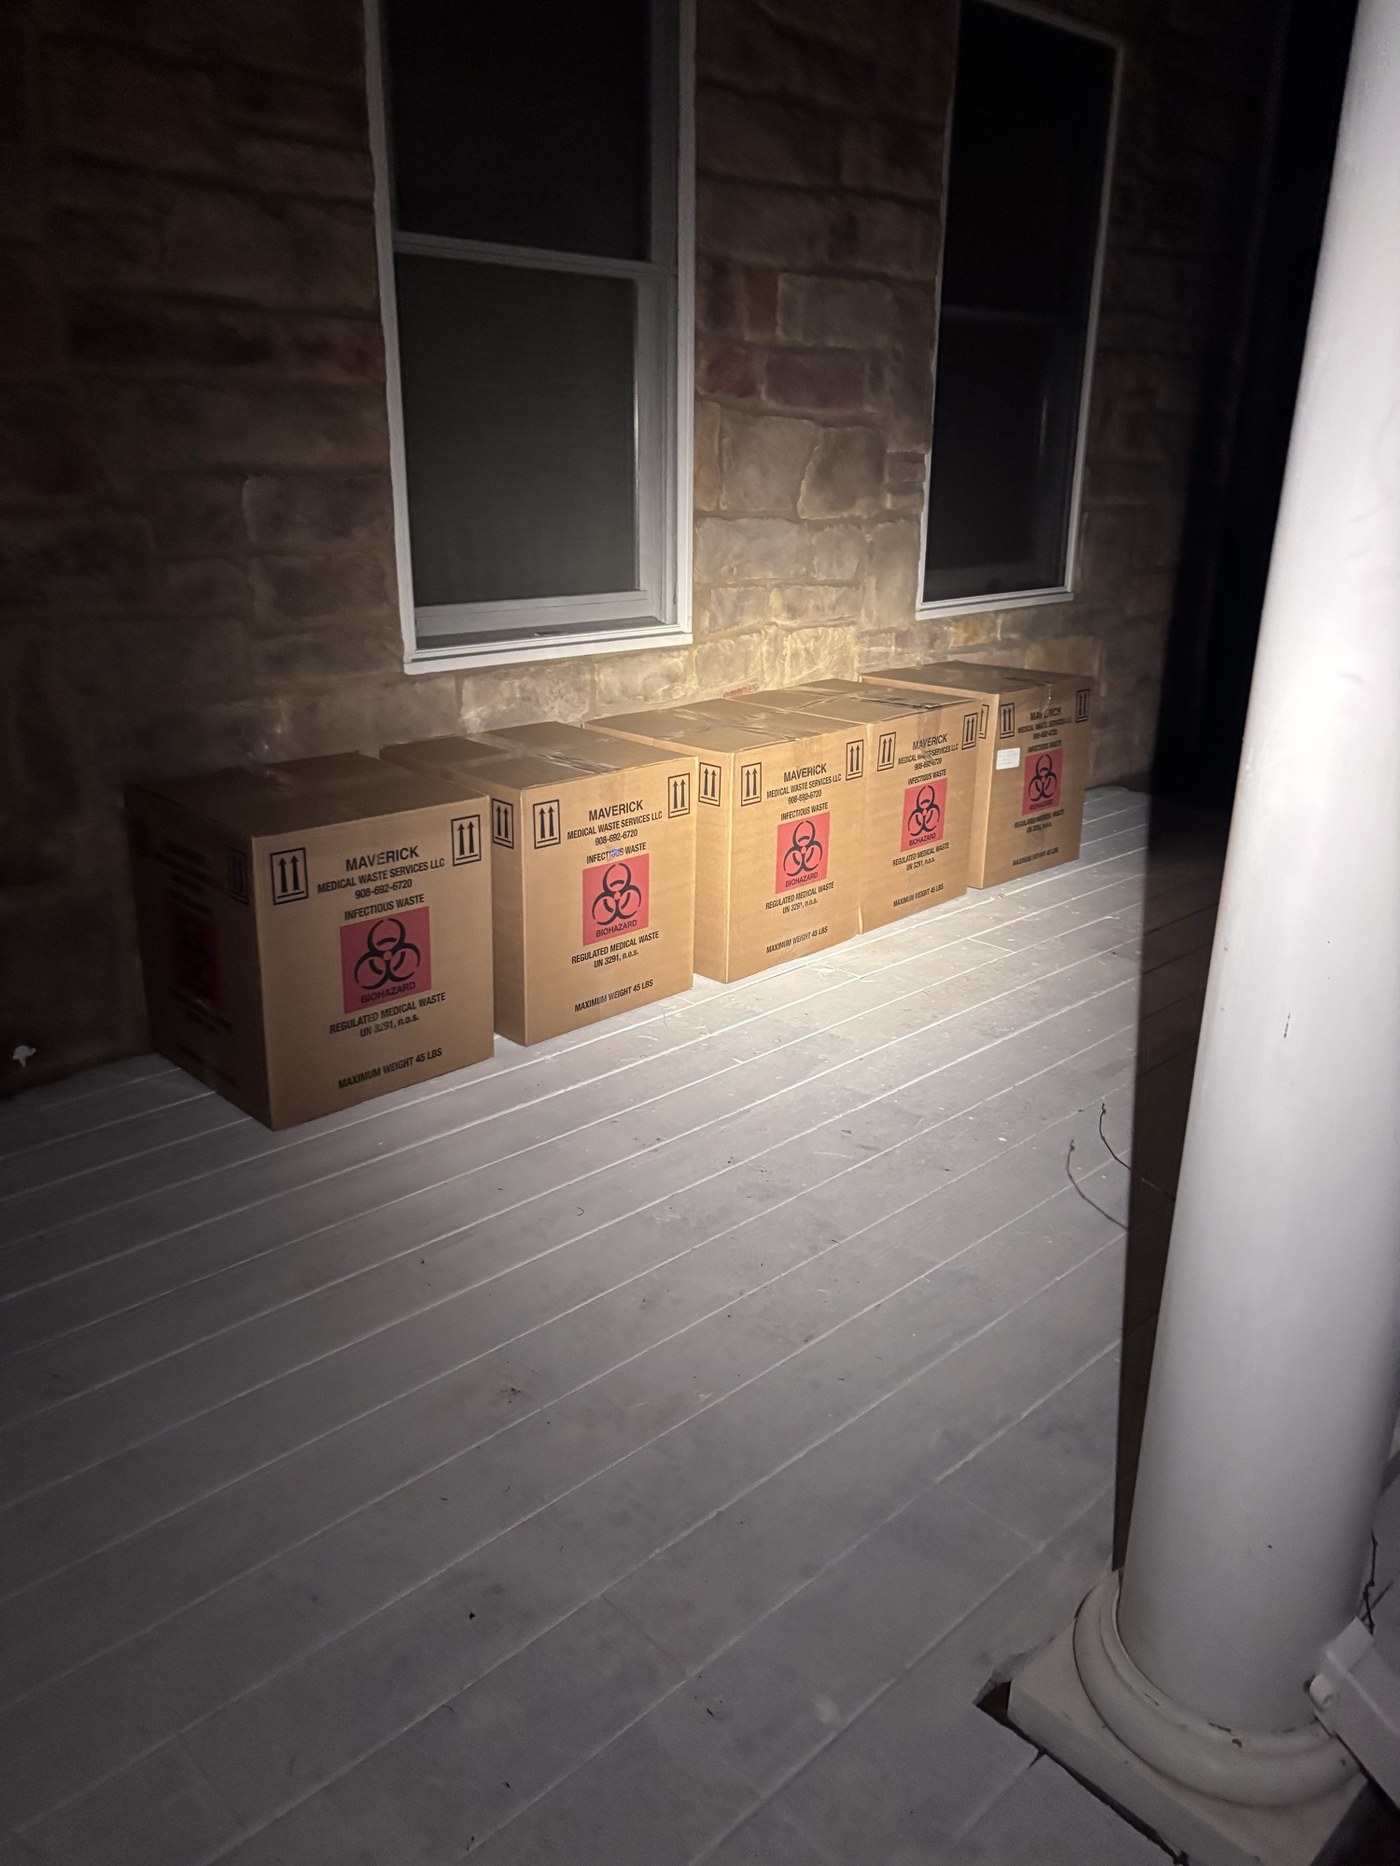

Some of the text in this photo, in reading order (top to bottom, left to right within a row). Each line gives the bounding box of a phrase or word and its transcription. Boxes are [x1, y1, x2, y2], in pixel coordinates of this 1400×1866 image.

[912, 733, 947, 750] MAVERICK
[898, 754, 917, 765] MEDICAL
[783, 763, 827, 783] MAVERICK
[908, 769, 947, 785] INFECTIOUS WASTE
[766, 773, 841, 799] MEDICAL WASTE SERVICES LLC
[588, 799, 643, 821] MAVERICK
[781, 802, 828, 821] INFECTIOUS WASTE
[567, 811, 662, 840] MEDICAL WASTE SERVICES LLC
[594, 829, 638, 846] 908-692-6720
[625, 842, 646, 855] WASTE
[909, 833, 936, 846] BIOHAZARD
[345, 845, 419, 872] MAVERICK
[893, 842, 949, 866] REGULATED MEDICAL WASTE
[317, 858, 445, 894] MEDICAL WASTE SERVICES LLC
[785, 872, 818, 888] BIOHAZARD
[354, 879, 412, 899] 908-692-6720
[765, 881, 834, 910] REGULATED MEDICAL WASTE
[893, 895, 914, 907] MAXIMUM
[915, 888, 929, 901] WEIGHT
[936, 883, 944, 892] LBS
[344, 894, 425, 921] INFECTIOUS WASTE
[782, 905, 790, 914] UN
[595, 919, 637, 938] BIOHAZARD
[571, 931, 659, 964] REGULATED MEDICAL WASTE
[766, 926, 828, 954] MAXIMUM WEIGHT 45 LBS
[594, 958, 603, 968] UN
[604, 953, 621, 966] 3291,
[361, 981, 416, 1003] BIOHAZARD
[574, 979, 653, 1012] MAXIMUM WEIGHT 45 LBS
[329, 992, 446, 1034] REGULATED MEDICAL WASTE
[360, 1026, 372, 1038] UN
[397, 1014, 419, 1027] n.o.s.
[338, 1047, 442, 1089] MAXIMUM WEIGHT 45 LBS
